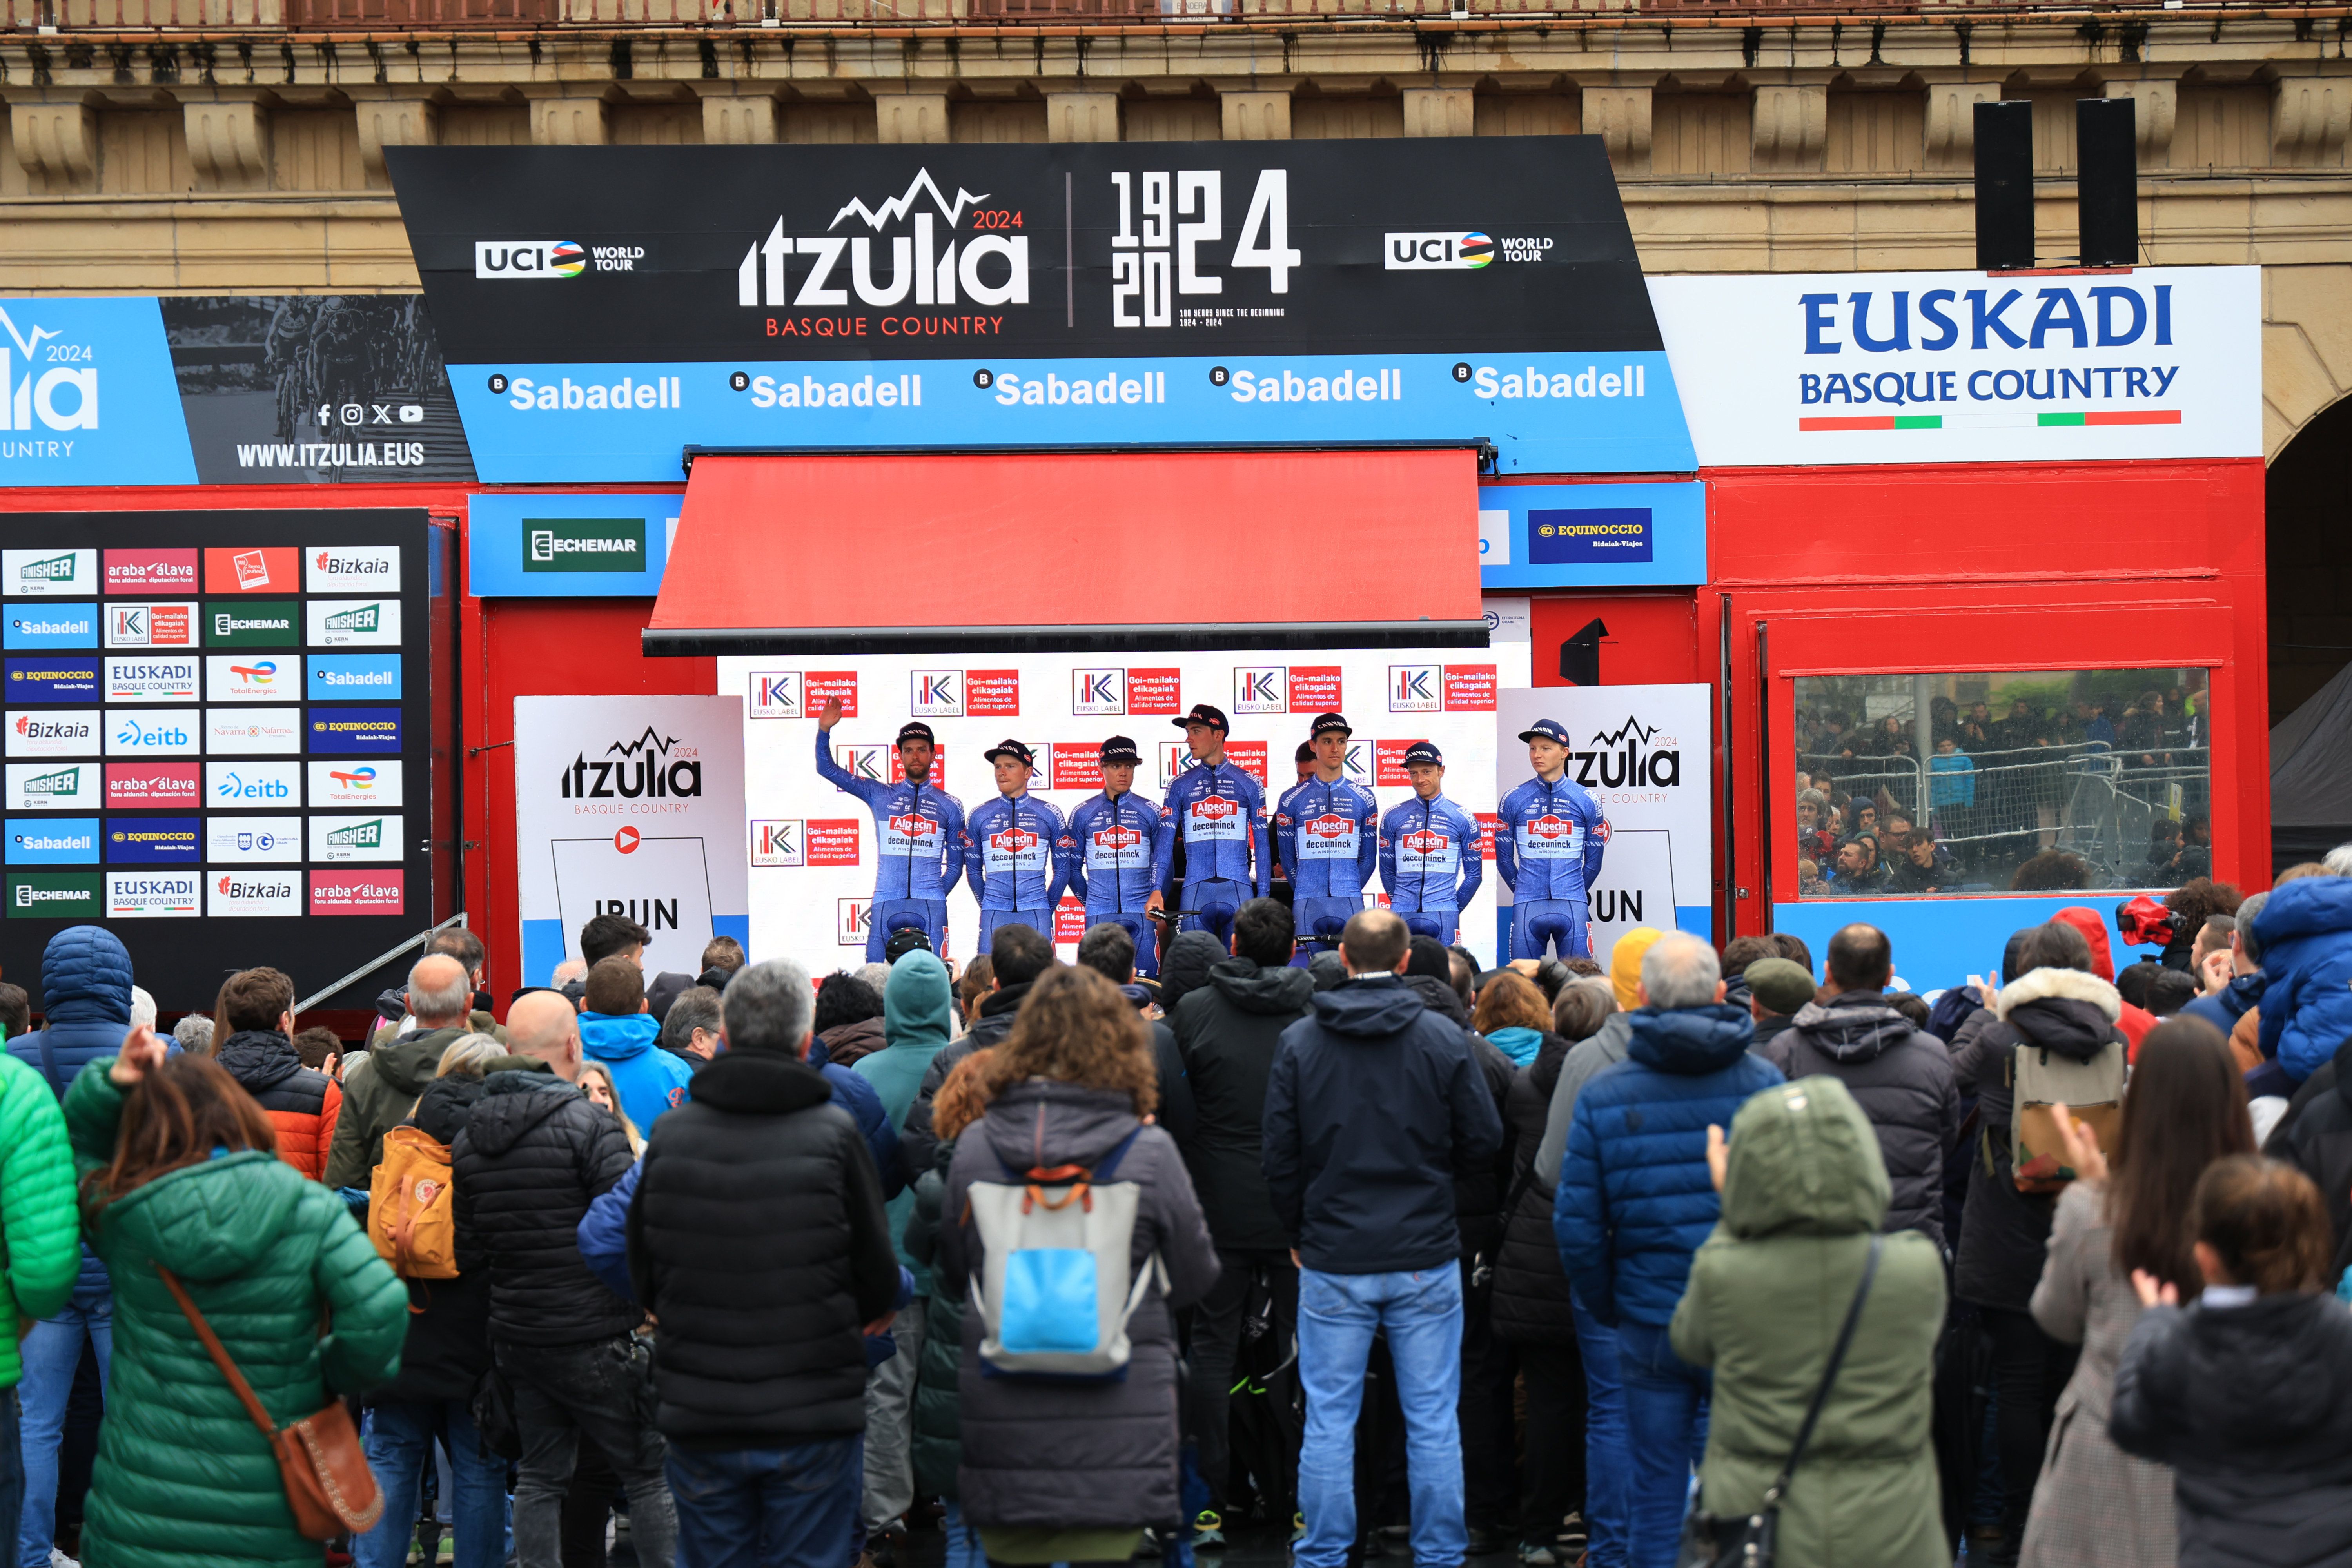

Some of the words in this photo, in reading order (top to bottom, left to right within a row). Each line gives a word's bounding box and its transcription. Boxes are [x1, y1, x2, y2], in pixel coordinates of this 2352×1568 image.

[973, 211, 1023, 229] 2024
[1393, 239, 1454, 262] UCI
[1501, 238, 1553, 250] WORLD
[1503, 250, 1541, 262] TOUR
[483, 249, 544, 270] UCI
[592, 247, 644, 259] WORLD
[595, 258, 633, 270] TOUR
[1194, 309, 1213, 317] YEARS
[1251, 308, 1285, 316] BEGINNING
[1180, 318, 1196, 327] 1924
[1798, 284, 2173, 355] EUSKADI
[766, 318, 867, 337] BASQUE
[882, 316, 1003, 335] COUNTRY
[47, 346, 93, 361] 2024
[995, 372, 1165, 405] Sabadell
[1231, 369, 1401, 403] Sabadell
[1474, 365, 1644, 399] Sabadell
[1798, 369, 1958, 408] BASQUE
[1967, 365, 2180, 404] COUNTRY
[510, 377, 680, 410] Sabadell
[751, 374, 921, 407] Sabadell
[3, 441, 74, 458] UNTRY
[238, 443, 424, 466] WWW.ITZULIA.EUS
[1558, 524, 1642, 536] EQUINOCCIO
[554, 539, 636, 552] ECHEMAR
[22, 559, 71, 577] FINISHER
[109, 564, 145, 576] araba
[156, 563, 193, 576] álava
[328, 559, 388, 573] Bizkaia
[231, 620, 289, 628] ECHEMAR
[326, 610, 375, 628] FINISHER
[21, 621, 88, 634] Sabadell
[113, 666, 191, 679] EUSKADI
[326, 672, 392, 685] Sabadell
[1445, 673, 1495, 682] Goi-mailako
[806, 679, 856, 688] Goi-mailako
[967, 677, 1017, 686] Goi-mailako
[1450, 681, 1491, 691] elikagaiak
[810, 688, 852, 697] elikagaiak
[972, 686, 1013, 695] elikagaiak
[28, 723, 89, 738] Bizkaia
[143, 727, 187, 746] eitb
[1655, 737, 1677, 746] 2024
[674, 747, 698, 757] 2024
[25, 773, 74, 793] FINISHER
[111, 778, 147, 790] araba
[158, 777, 195, 789] álava
[244, 779, 288, 797] eitb
[1612, 793, 1668, 804] COUNTRY
[575, 804, 624, 814] BASQUE
[631, 803, 689, 814] COUNTRY
[1196, 802, 1233, 814] Alpecin
[894, 818, 932, 831] Alpecin
[1193, 820, 1235, 831] deceuninck
[1311, 820, 1349, 833] Alpecin
[1533, 822, 1567, 833] Alpecin
[128, 833, 194, 841] EQUINOCCIO
[328, 825, 377, 844] FINISHER
[995, 834, 1033, 847] Alpecin
[1100, 831, 1136, 844] Alpecin
[23, 836, 90, 849] Sabadell
[888, 836, 933, 848] deceuninck
[1306, 839, 1351, 849] deceuninck
[1407, 836, 1443, 848] Alpecin
[992, 852, 1036, 861] deceuninck
[1095, 850, 1140, 859] deceuninck
[1403, 854, 1446, 862] deceuninck
[114, 880, 193, 895] EUSKADI
[230, 884, 290, 898] Bizkaia
[314, 884, 351, 897] araba
[362, 884, 399, 897] álava
[32, 890, 90, 900] ECHEMAR
